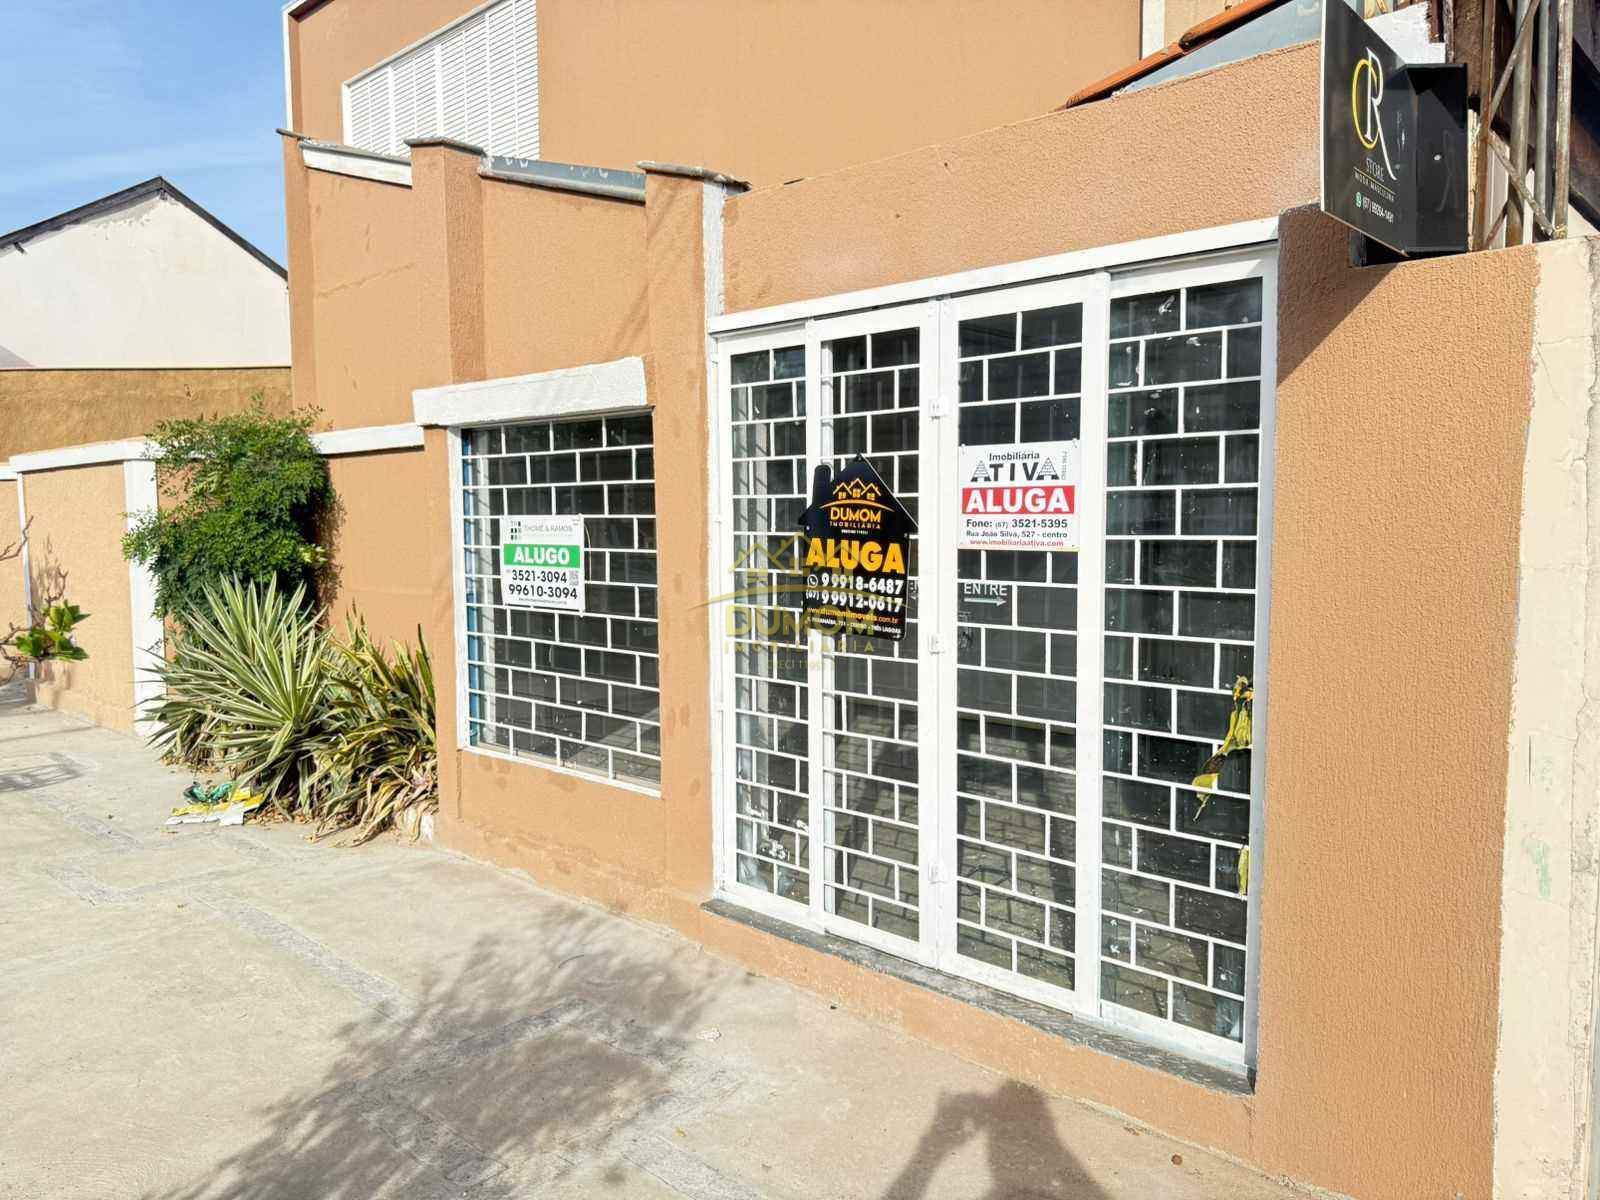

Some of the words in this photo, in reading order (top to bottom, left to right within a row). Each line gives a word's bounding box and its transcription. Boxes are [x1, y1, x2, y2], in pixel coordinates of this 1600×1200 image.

[989, 451, 1041, 462] Imobiliária
[971, 457, 1060, 482] ATIVA
[965, 487, 1071, 513] ALUGA
[830, 507, 882, 523] DUMOM
[966, 519, 993, 528] Fone:
[1011, 518, 1068, 529] 3521-5395
[999, 529, 1020, 539] Silva,
[1021, 530, 1036, 538] 527
[1042, 530, 1068, 539] centro
[513, 546, 570, 565] ALUGO
[805, 537, 906, 574] ALUGA
[512, 569, 568, 583] 3521-3094
[508, 583, 578, 600] 99610-3094
[805, 589, 820, 600] (67)
[963, 582, 1008, 596] ENTRE
